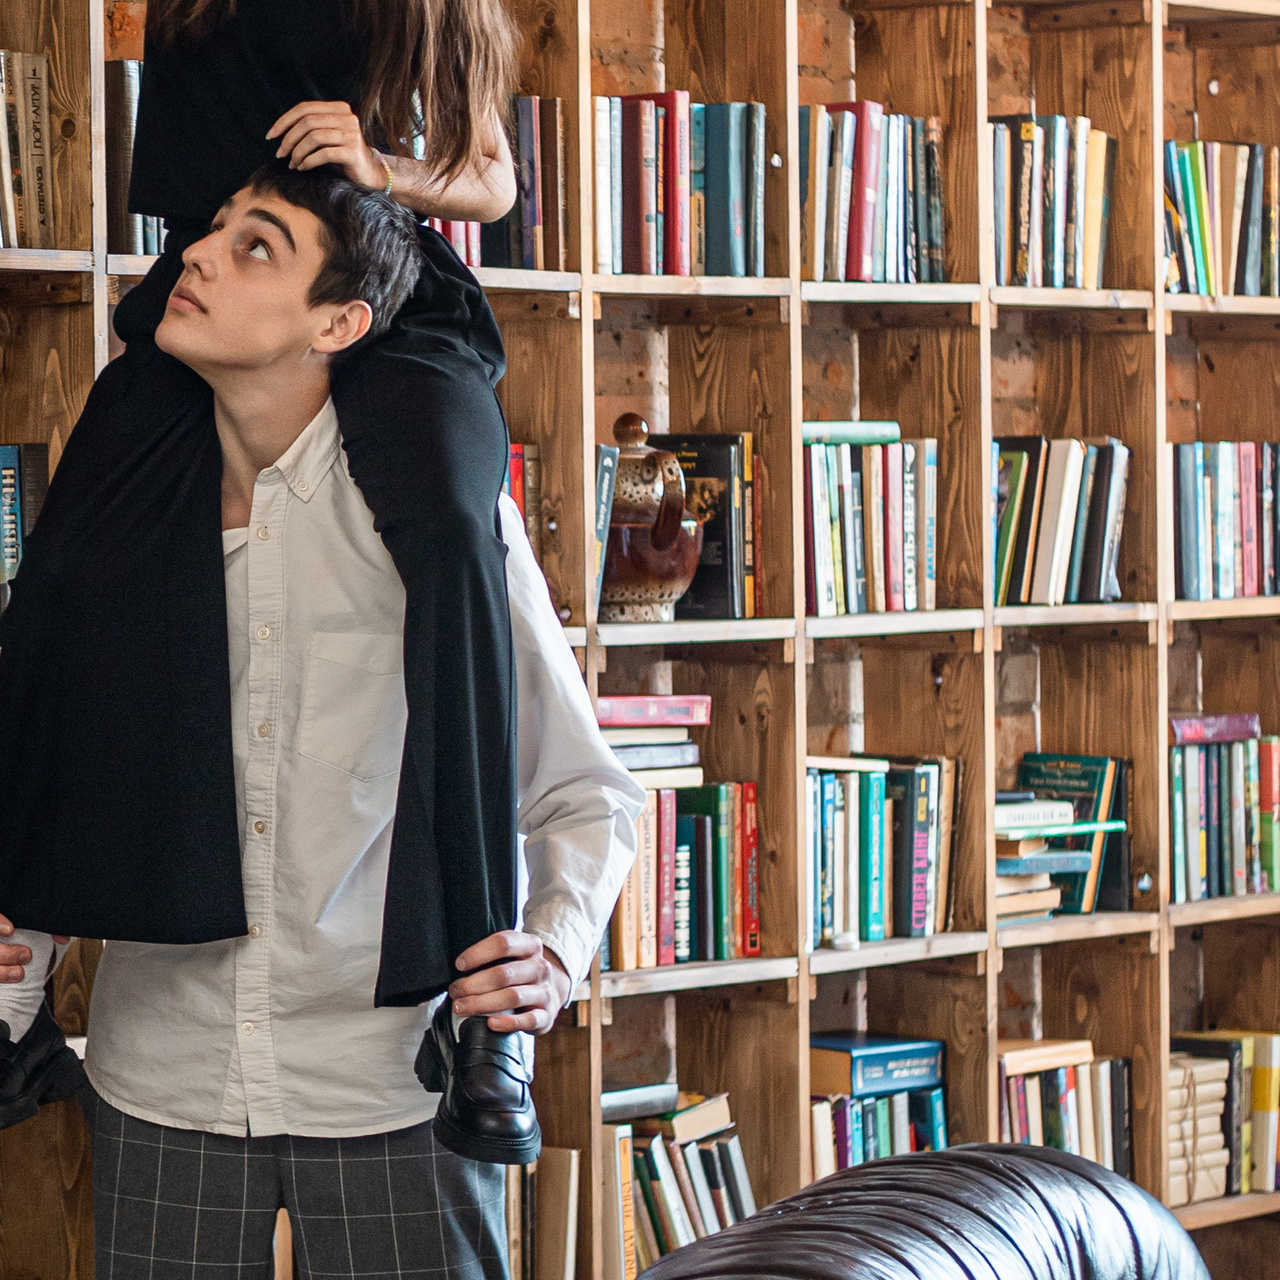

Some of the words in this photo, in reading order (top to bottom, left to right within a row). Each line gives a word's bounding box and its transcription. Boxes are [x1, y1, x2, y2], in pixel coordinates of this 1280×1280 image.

[30, 83, 42, 149] ПОРТ-АРТУР
[35, 166, 46, 215] СТЕПАНОВ
[1, 468, 19, 564] ЦЫГАН
[914, 830, 928, 869] КИНГ
[912, 873, 926, 929] СТИВЕН
